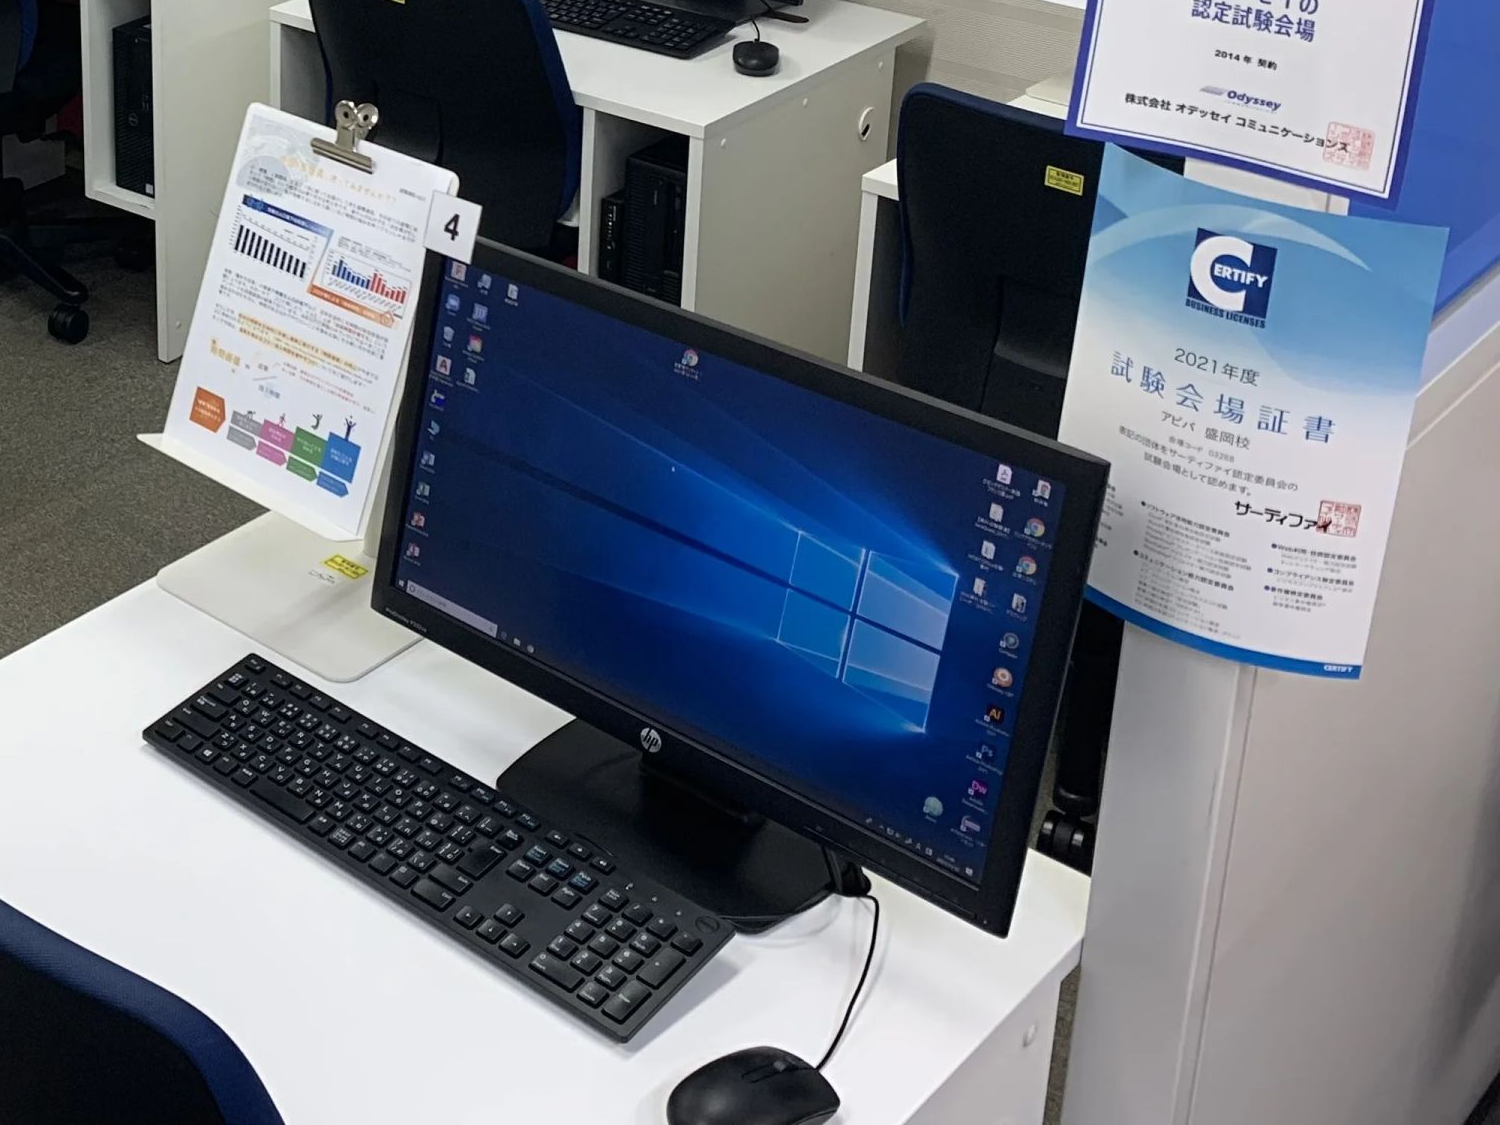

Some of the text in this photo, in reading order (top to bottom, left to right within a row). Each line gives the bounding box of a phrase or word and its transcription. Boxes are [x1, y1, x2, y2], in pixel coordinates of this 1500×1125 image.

[1214, 49, 1277, 71] 2014年 契約
[1226, 89, 1282, 112] Odyssey
[1124, 93, 1349, 155] 株式会社 オデッセイ コミュニケーションズ
[443, 213, 461, 242] 4
[1185, 298, 1266, 329] BUSINESS LICENSES
[1174, 347, 1261, 387] 2021年度
[1110, 350, 1336, 444] 試験会場証書
[1161, 411, 1250, 451] アビバ 盛岡校
[1234, 500, 1332, 533] サーティファイ
[971, 780, 988, 795] Dw
